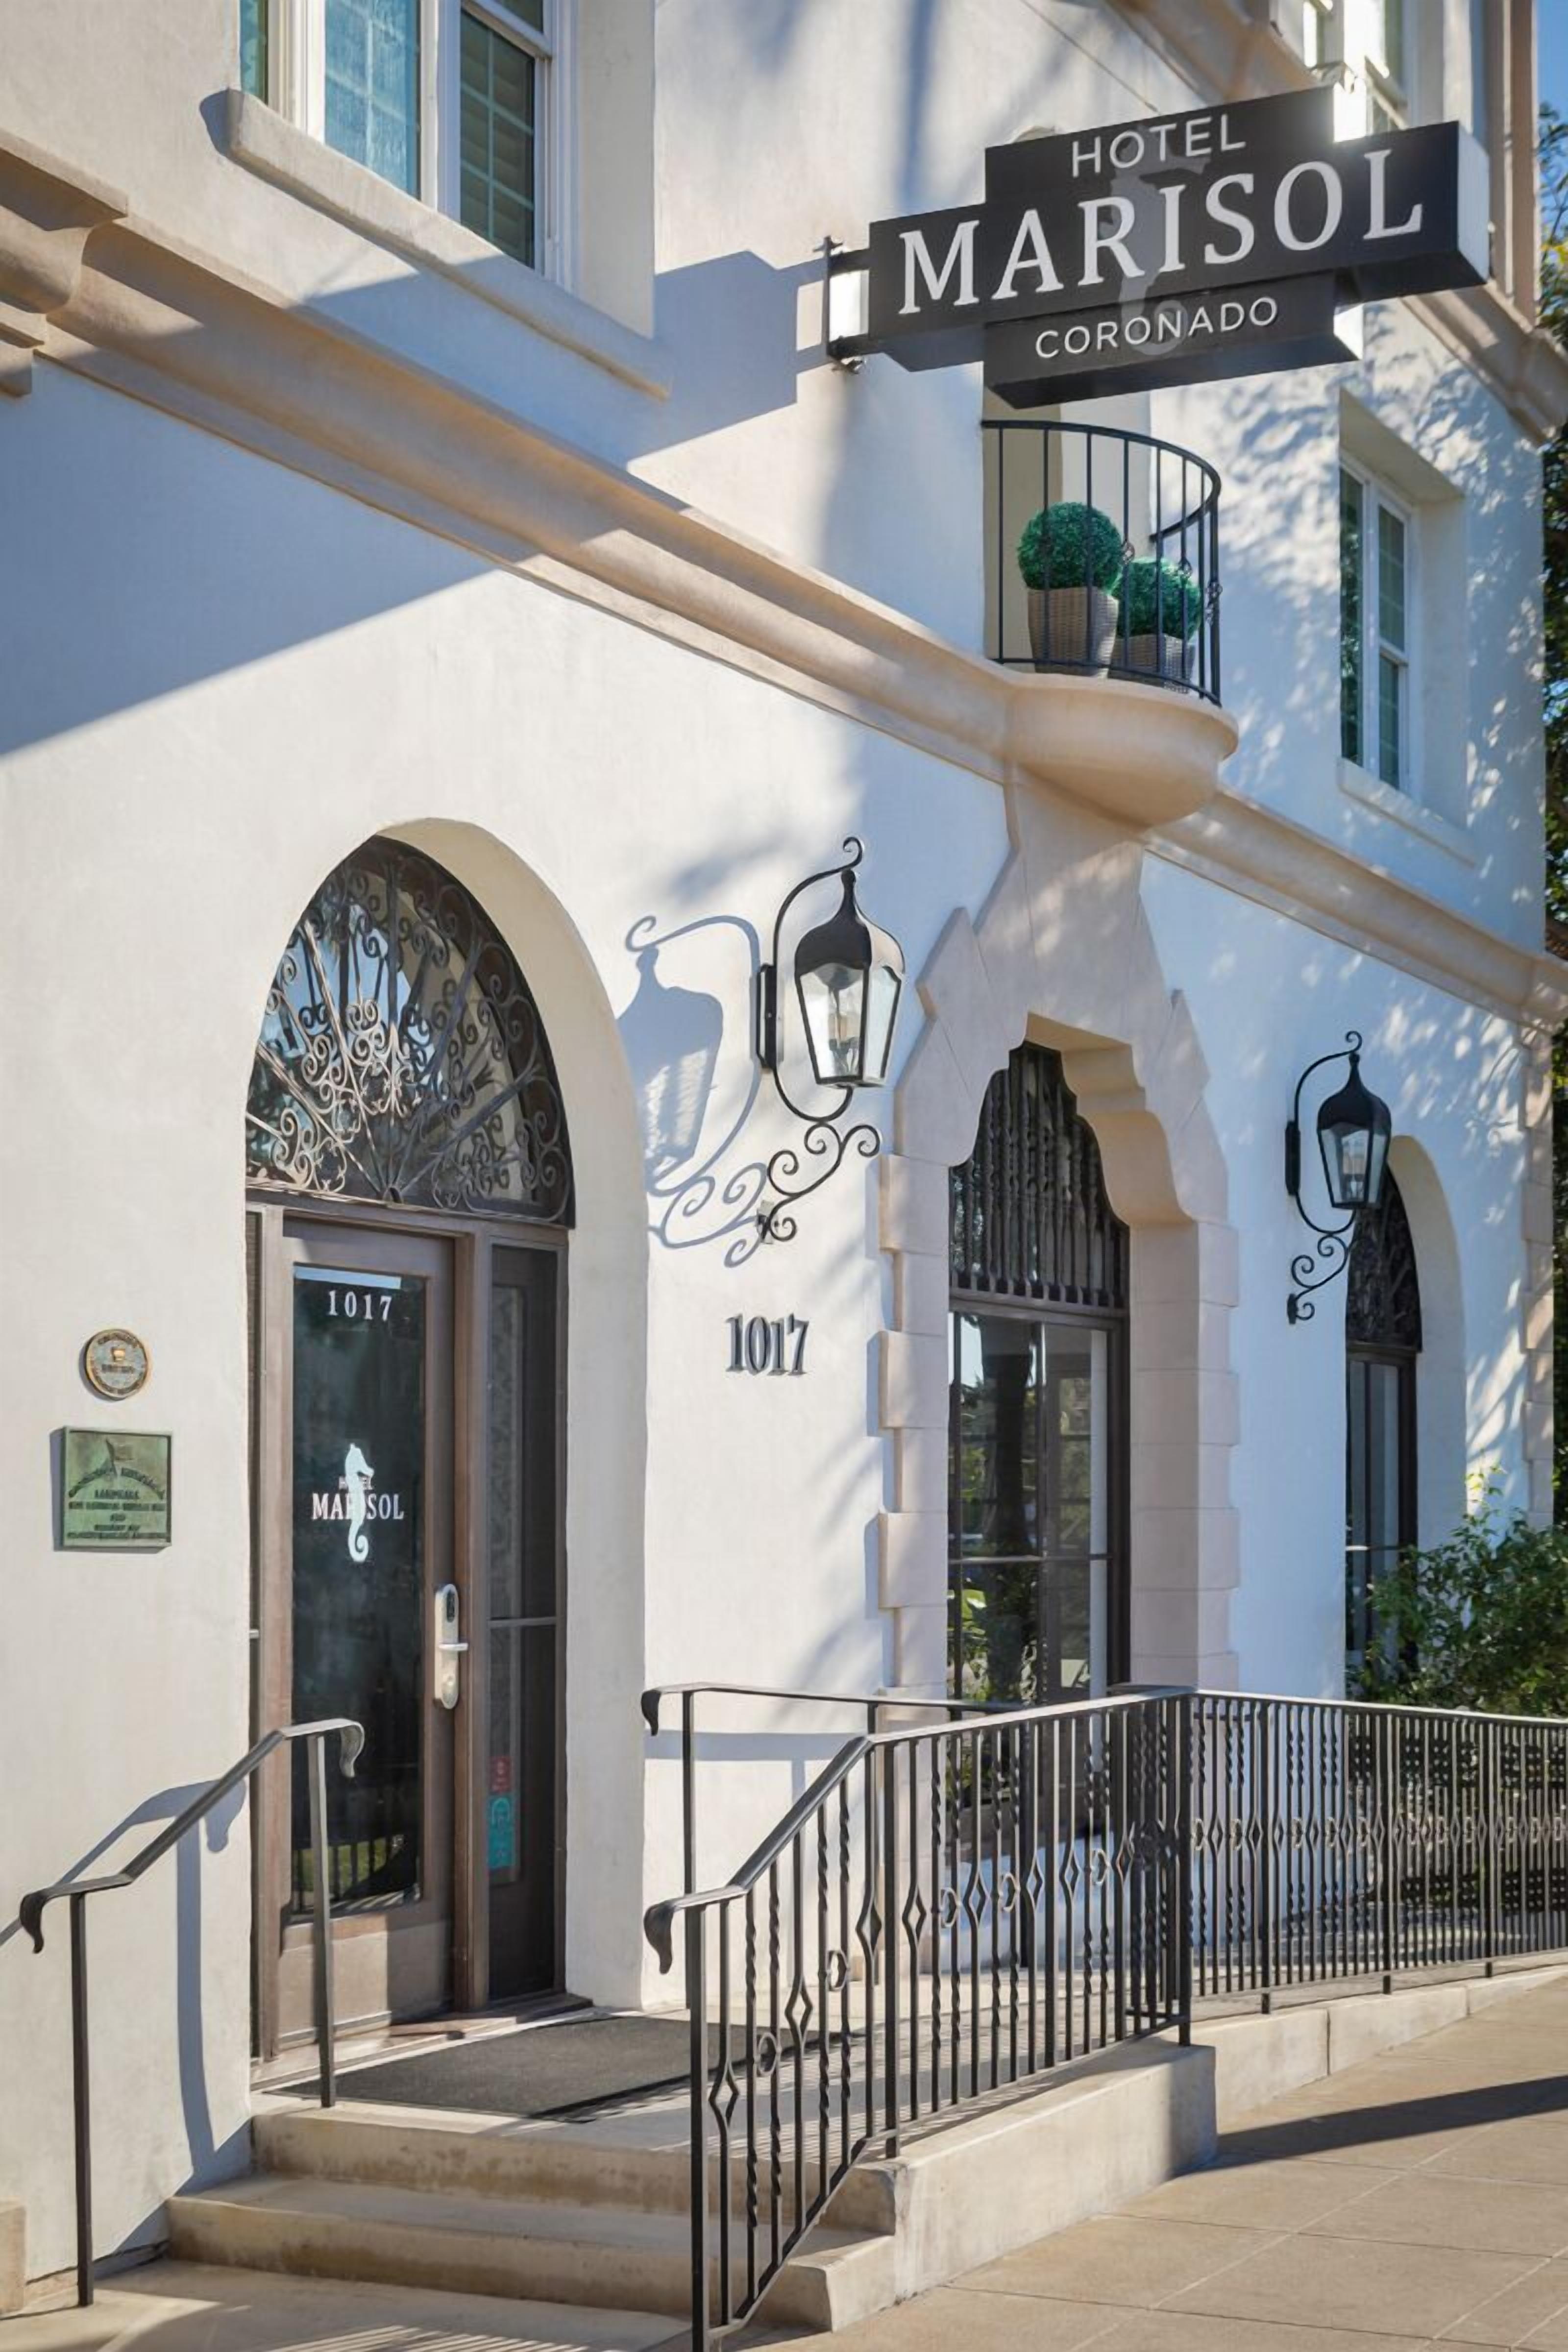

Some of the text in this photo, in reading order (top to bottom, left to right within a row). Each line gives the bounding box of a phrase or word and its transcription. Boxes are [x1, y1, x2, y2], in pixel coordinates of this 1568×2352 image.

[1072, 114, 1247, 178] HOTEL
[898, 148, 1423, 315] MARISOL
[1035, 296, 1277, 359] CORONADO
[328, 1290, 392, 1322] 1017
[725, 1312, 810, 1376] 1017
